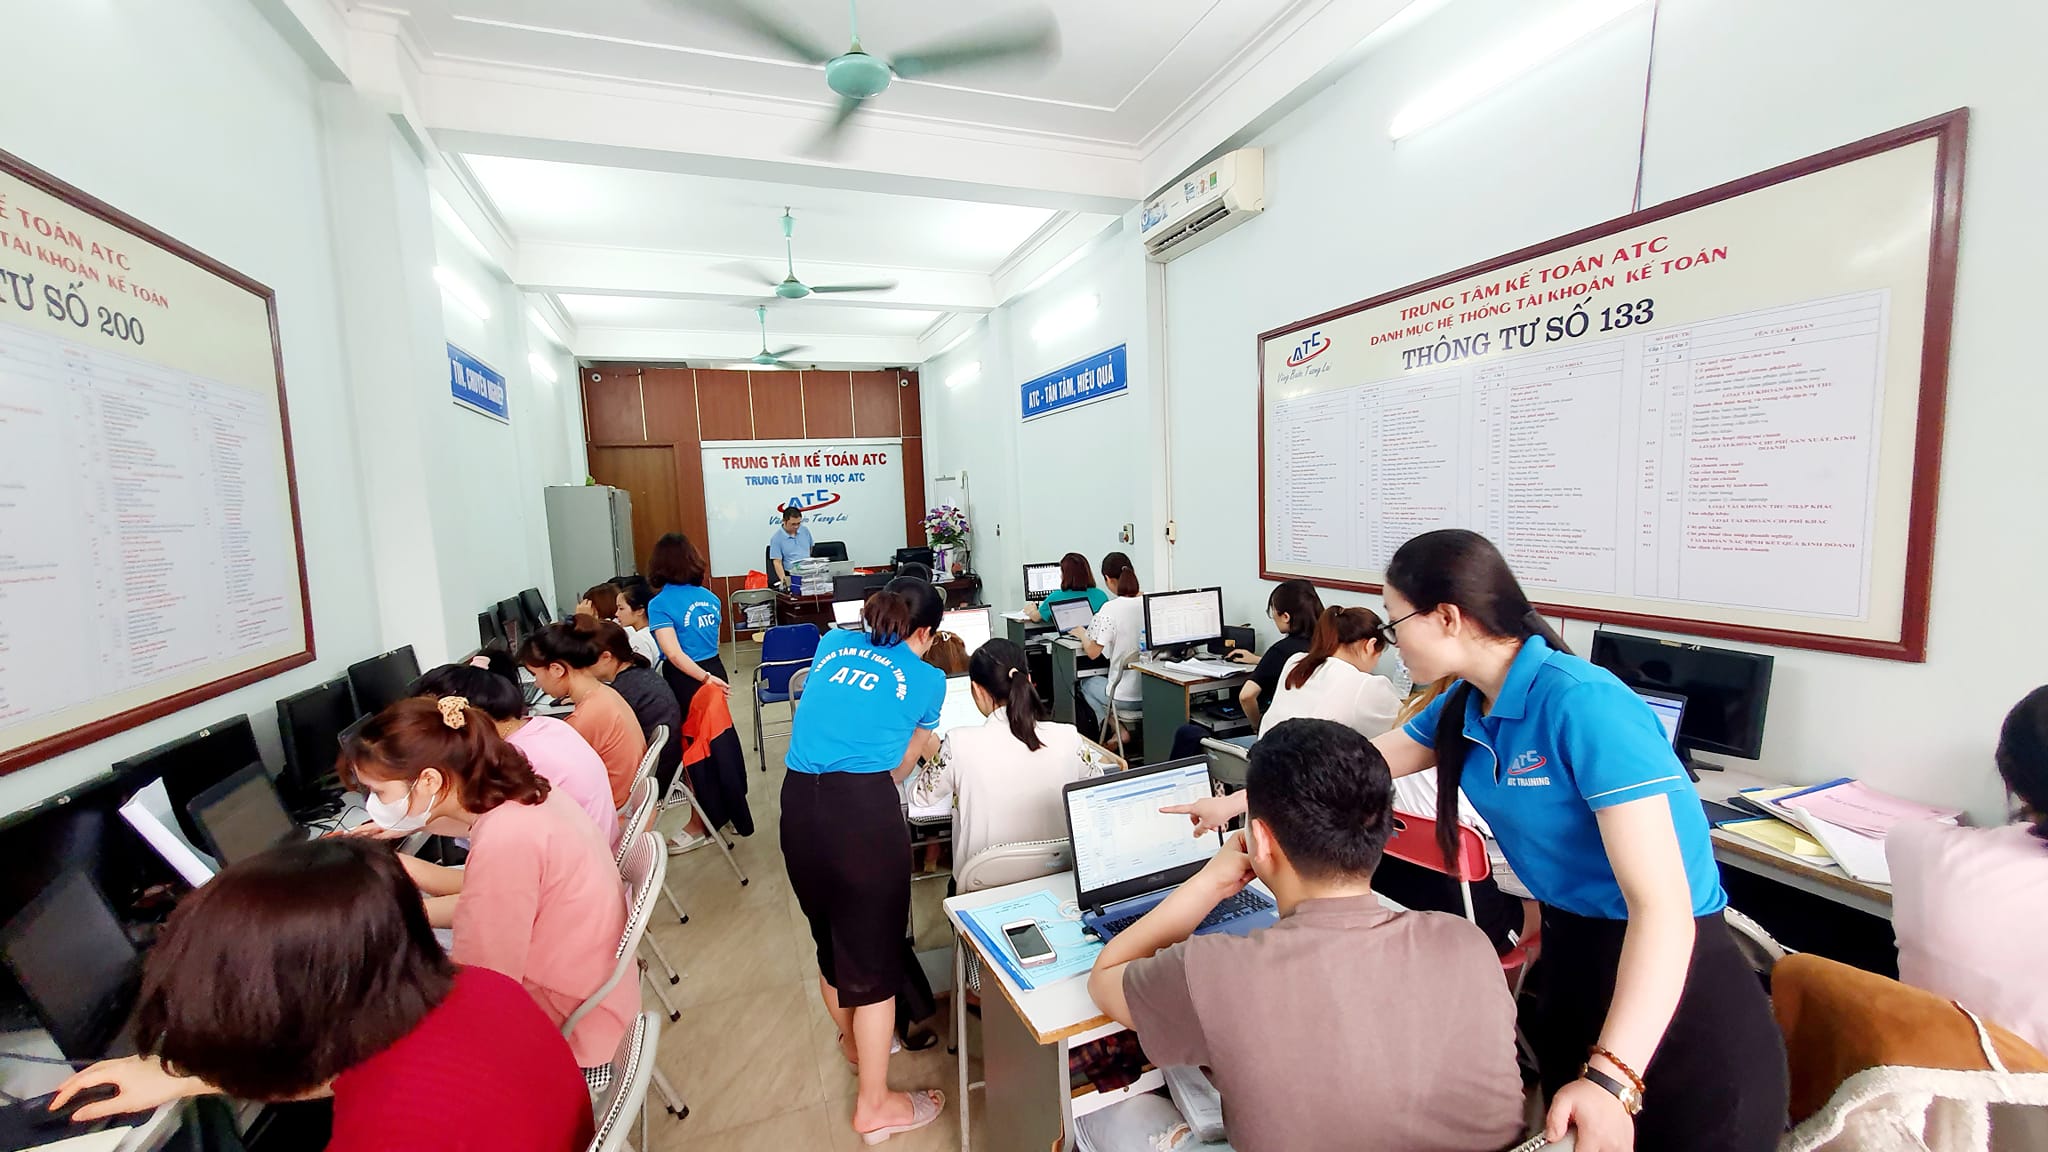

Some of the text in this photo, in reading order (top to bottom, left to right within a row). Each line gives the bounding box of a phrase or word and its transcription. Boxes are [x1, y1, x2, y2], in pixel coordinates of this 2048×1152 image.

[16, 207, 84, 251] TOÁN
[91, 241, 131, 271] ATC
[107, 274, 127, 293] KẾ
[130, 284, 170, 309] TOÁN
[1400, 236, 1669, 322] TRUNG TÂM KẾ TOÁN ATC
[1370, 246, 1729, 346] DANH MỤC HỆ THỐNG TÀI KHOẢN KẾ TOÁN
[43, 281, 90, 328] SỐ
[97, 306, 145, 346] 200
[1292, 331, 1321, 362] ATC
[1402, 297, 1655, 371] THÔNG TƯ SỐ 133
[1028, 390, 1040, 409] ATC
[1077, 368, 1095, 395] HIỆU
[1096, 354, 1114, 388] QUẢ
[722, 450, 887, 470] TRUNG TÂM KẾ TOÁN ATC
[745, 472, 866, 486] TRUNG TÂM TIN HỌC ATC
[788, 489, 829, 508] ATC
[698, 613, 715, 628] ATC
[838, 647, 858, 657] TÂM
[858, 649, 872, 659] KẾ
[871, 653, 893, 668] TOÁN
[828, 666, 880, 691] ATC
[1511, 750, 1539, 769] ATC
